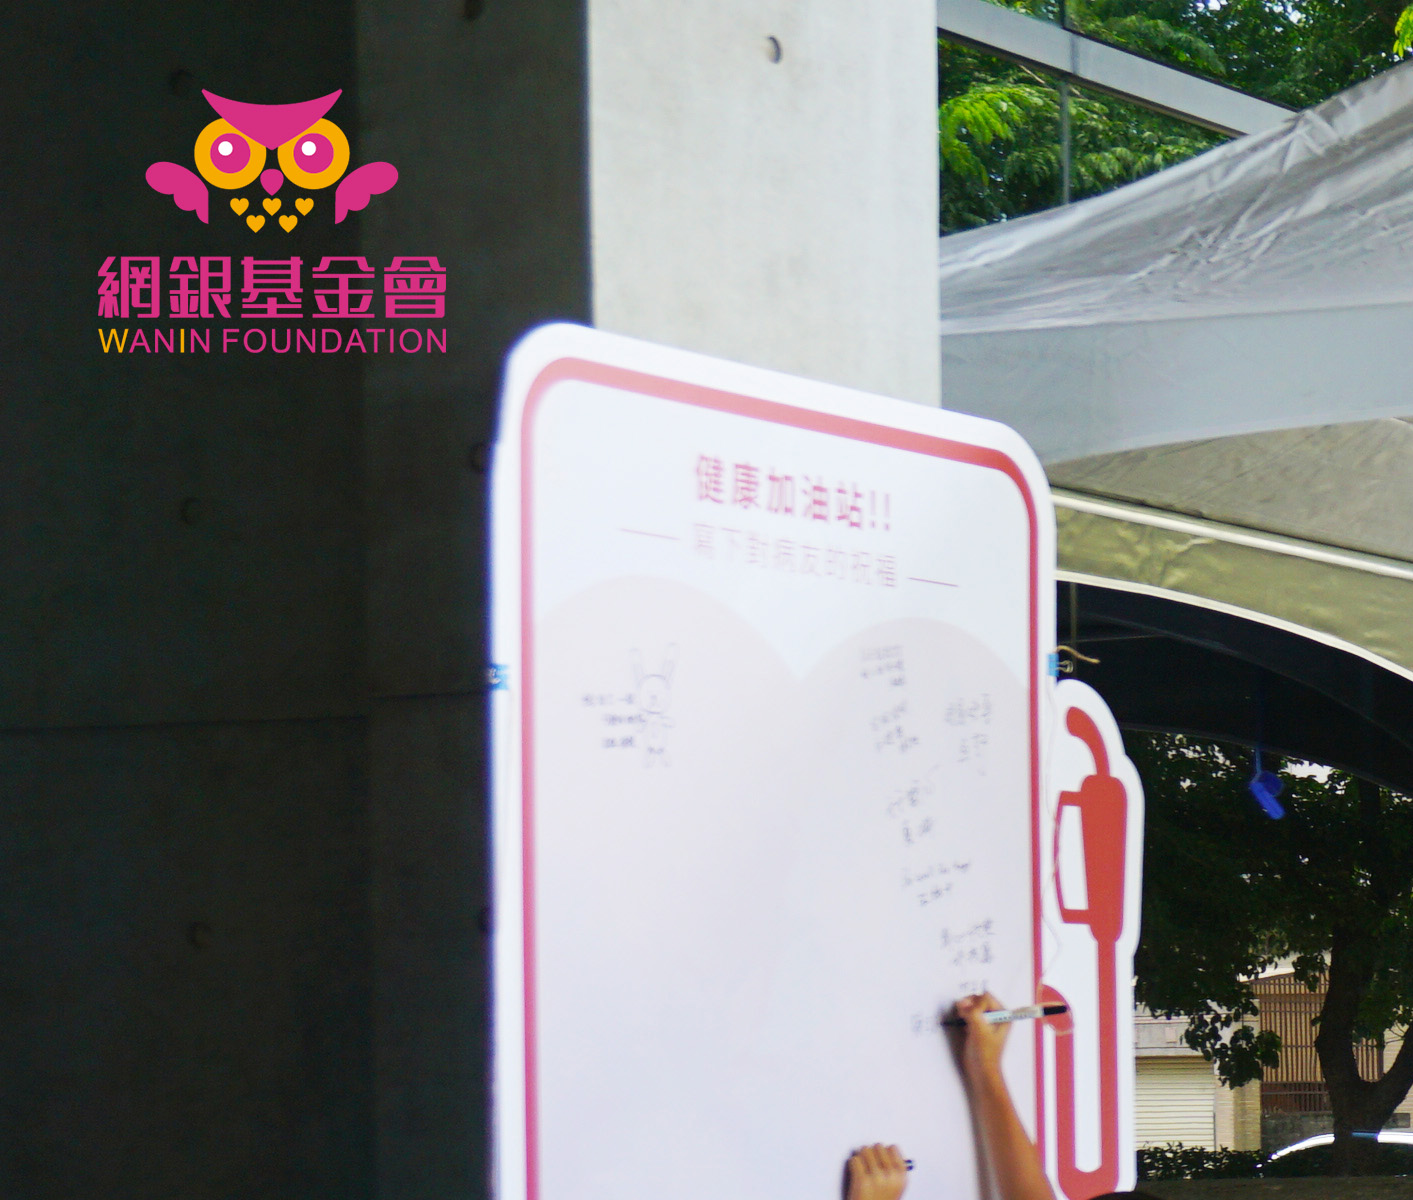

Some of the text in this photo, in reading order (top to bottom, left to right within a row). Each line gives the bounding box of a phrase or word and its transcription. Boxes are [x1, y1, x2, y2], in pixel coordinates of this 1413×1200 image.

[695, 454, 891, 531] 健康加油站!!
